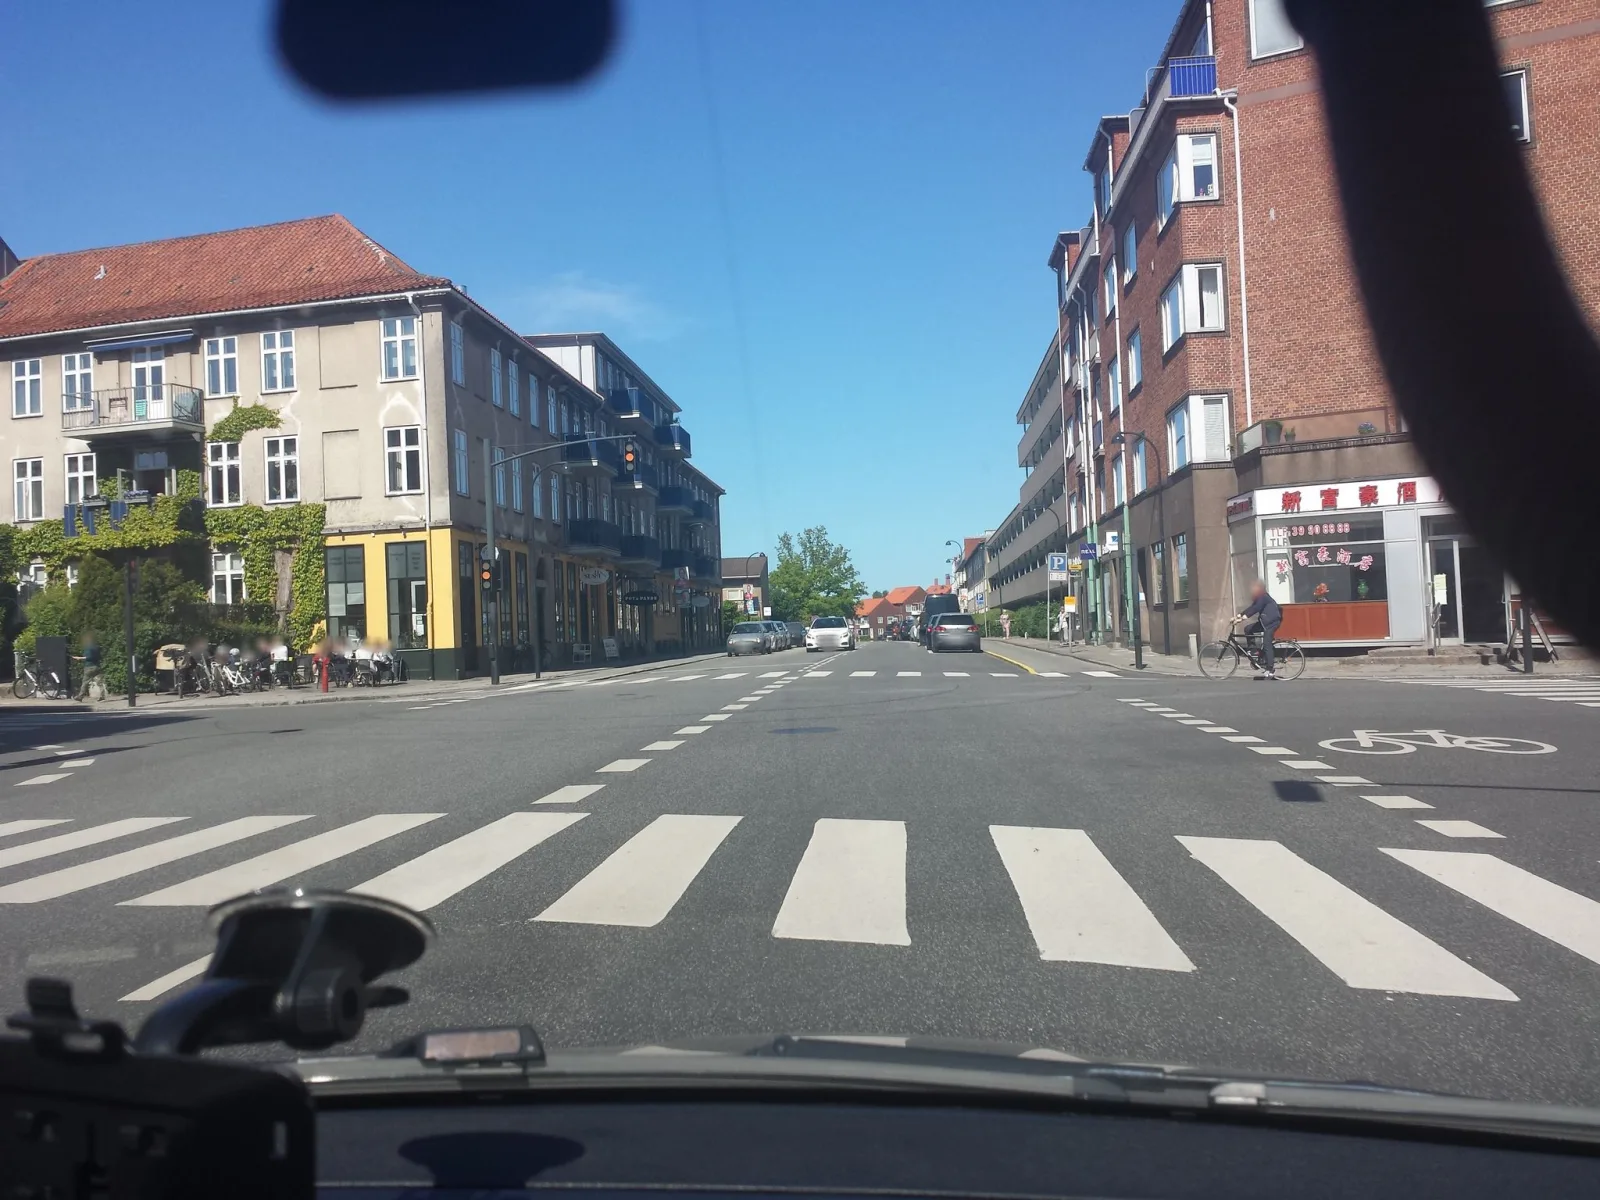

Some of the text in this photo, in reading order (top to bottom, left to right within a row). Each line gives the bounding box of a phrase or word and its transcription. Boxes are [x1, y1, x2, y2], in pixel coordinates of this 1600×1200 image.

[1281, 481, 1443, 513] 新富豪酒
[1052, 556, 1064, 570] P
